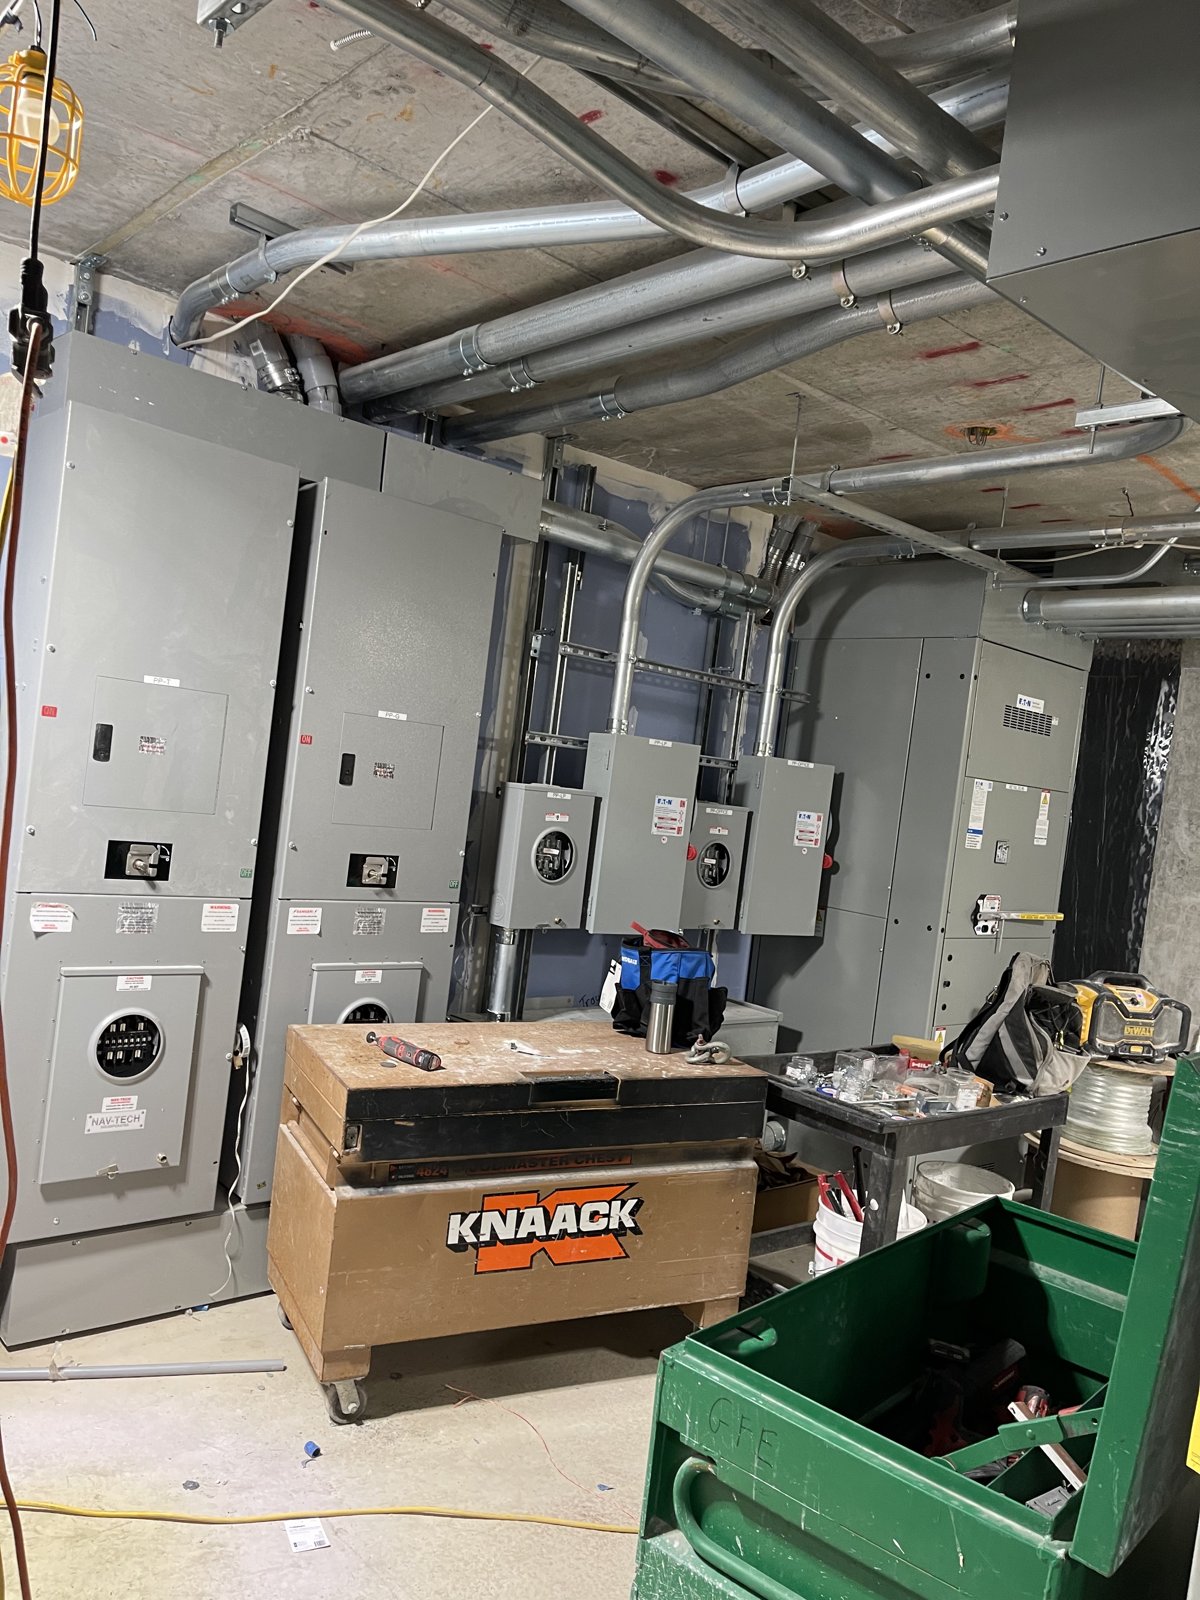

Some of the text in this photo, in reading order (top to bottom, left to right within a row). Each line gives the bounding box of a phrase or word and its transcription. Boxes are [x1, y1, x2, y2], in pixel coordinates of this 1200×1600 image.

[43, 707, 55, 716] ON
[301, 735, 312, 744] ON
[240, 869, 252, 877] OFF
[449, 880, 459, 888] OFF
[91, 1114, 141, 1127] NAV-TECH
[574, 1152, 624, 1165] CHEST
[446, 1196, 644, 1253] KNAACK
[708, 1397, 778, 1468] GFE
